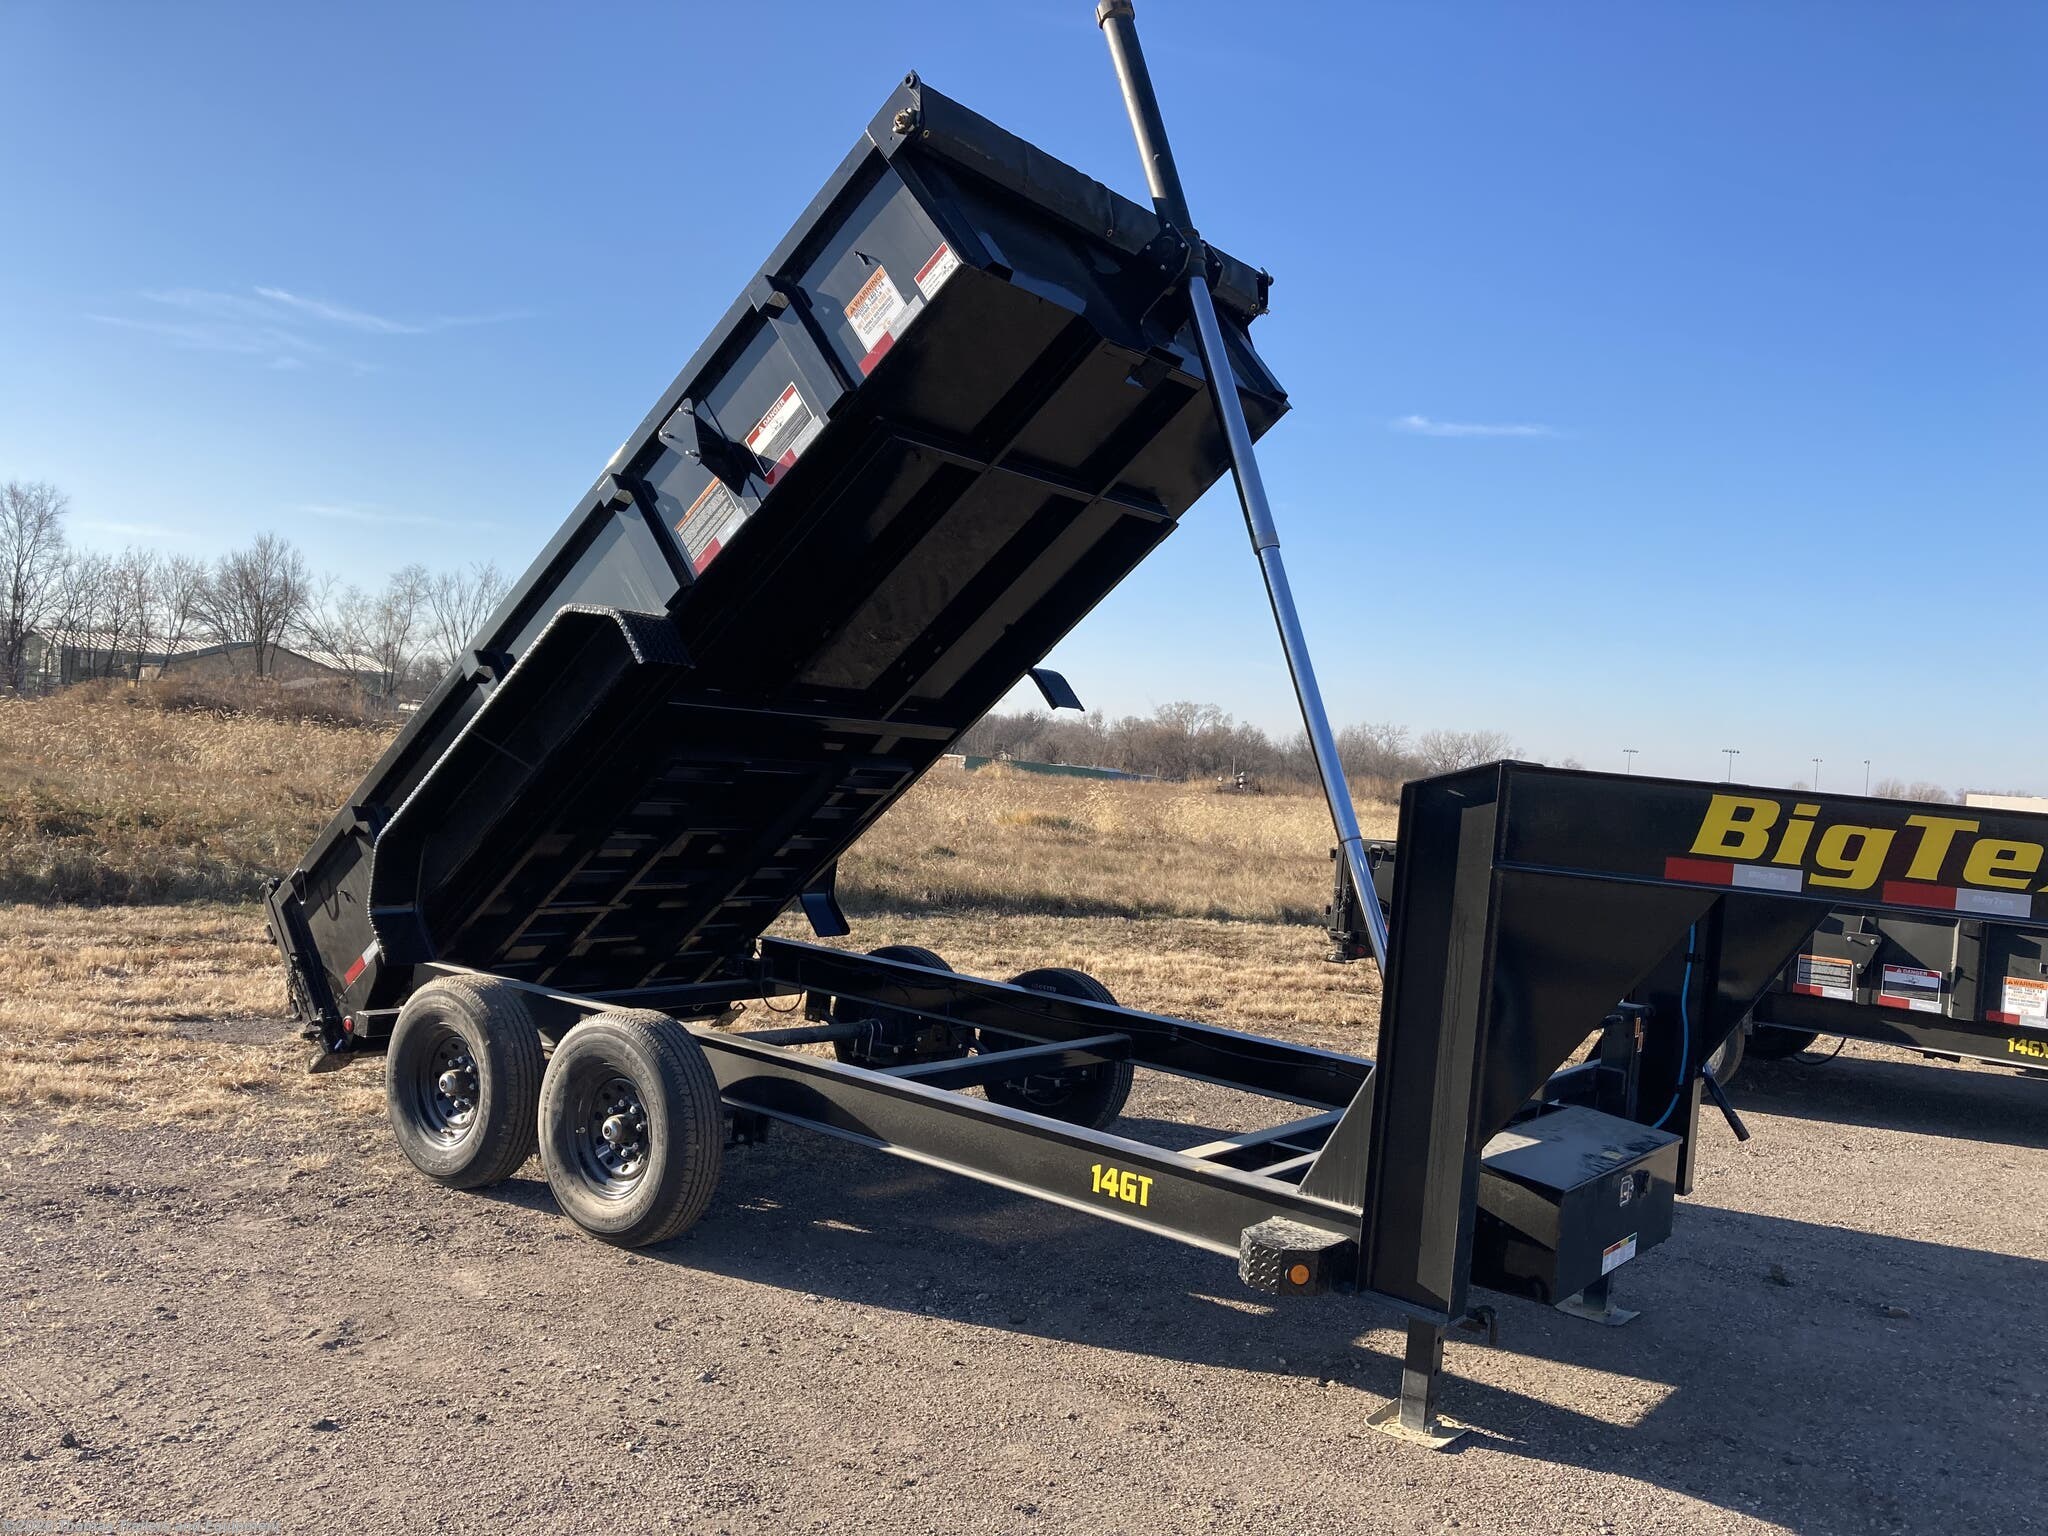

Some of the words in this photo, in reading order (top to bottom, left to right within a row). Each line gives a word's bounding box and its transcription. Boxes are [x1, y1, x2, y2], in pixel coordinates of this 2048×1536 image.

[852, 272, 882, 308] WARNING
[762, 397, 785, 427] DANGER
[1689, 793, 2048, 892] BigTe
[2013, 979, 2045, 989] WARNING
[1091, 1164, 1153, 1207] 14GT
